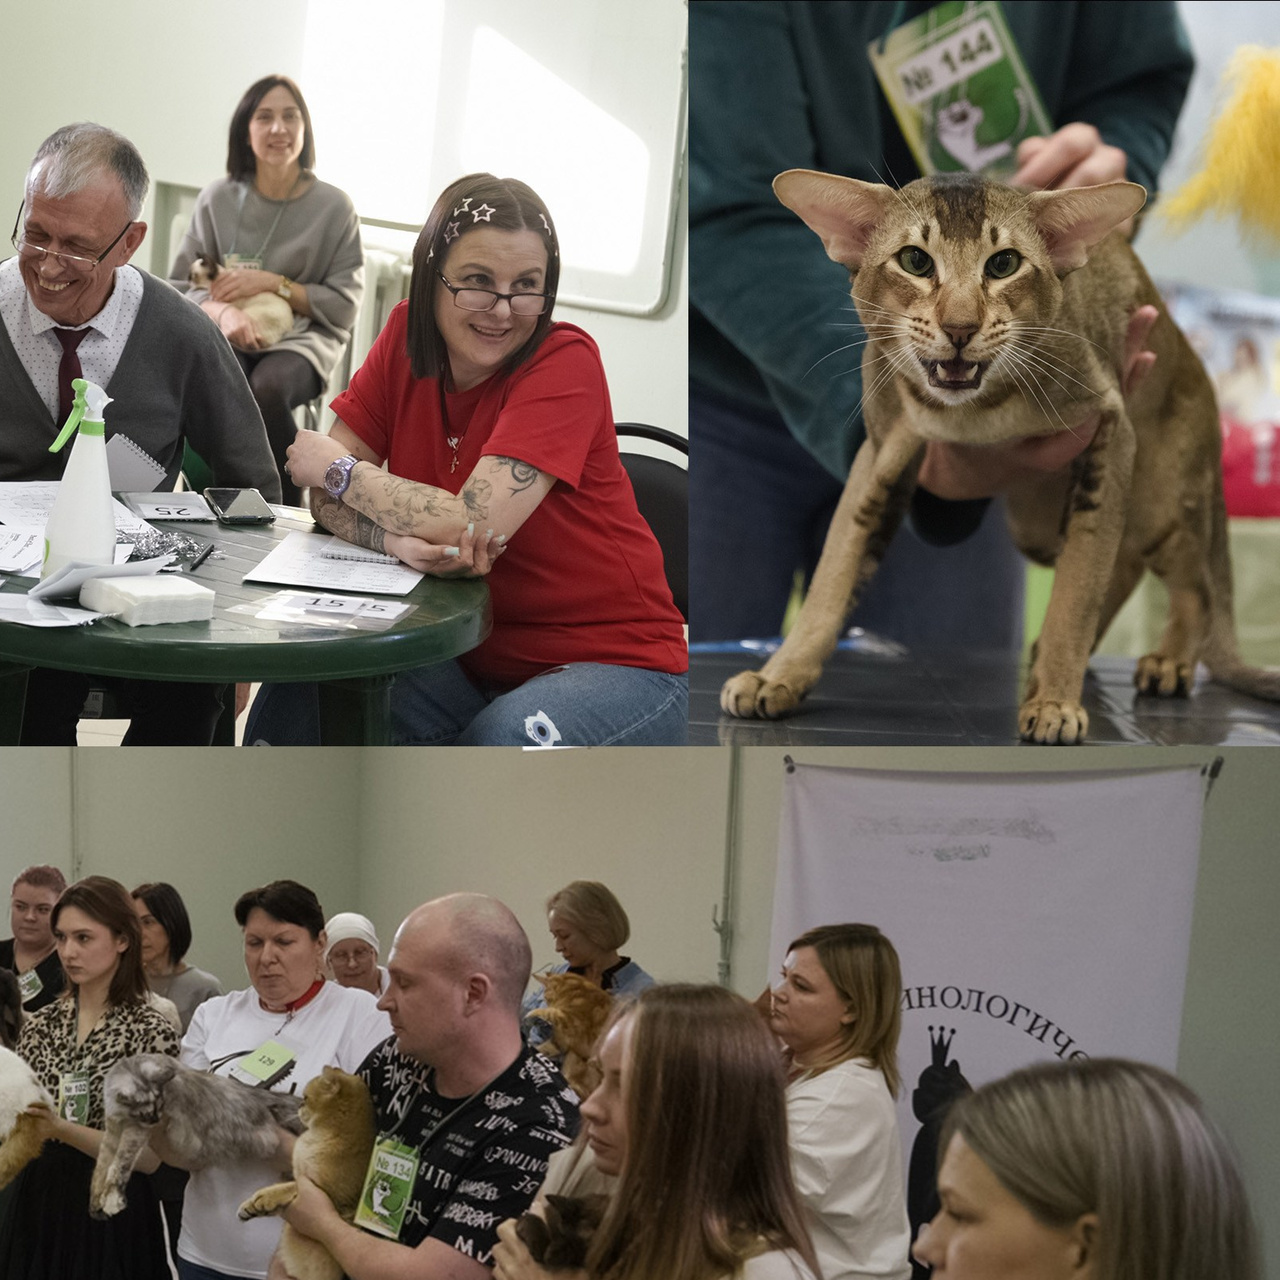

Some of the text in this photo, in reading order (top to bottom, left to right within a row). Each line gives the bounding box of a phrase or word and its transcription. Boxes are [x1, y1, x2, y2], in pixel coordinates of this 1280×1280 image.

[940, 30, 994, 73] 144
[155, 506, 191, 517] 25
[305, 597, 346, 609] 15
[483, 1145, 549, 1173] ONTINUED
[392, 1161, 412, 1179] 134
[511, 1174, 540, 1195] BE
